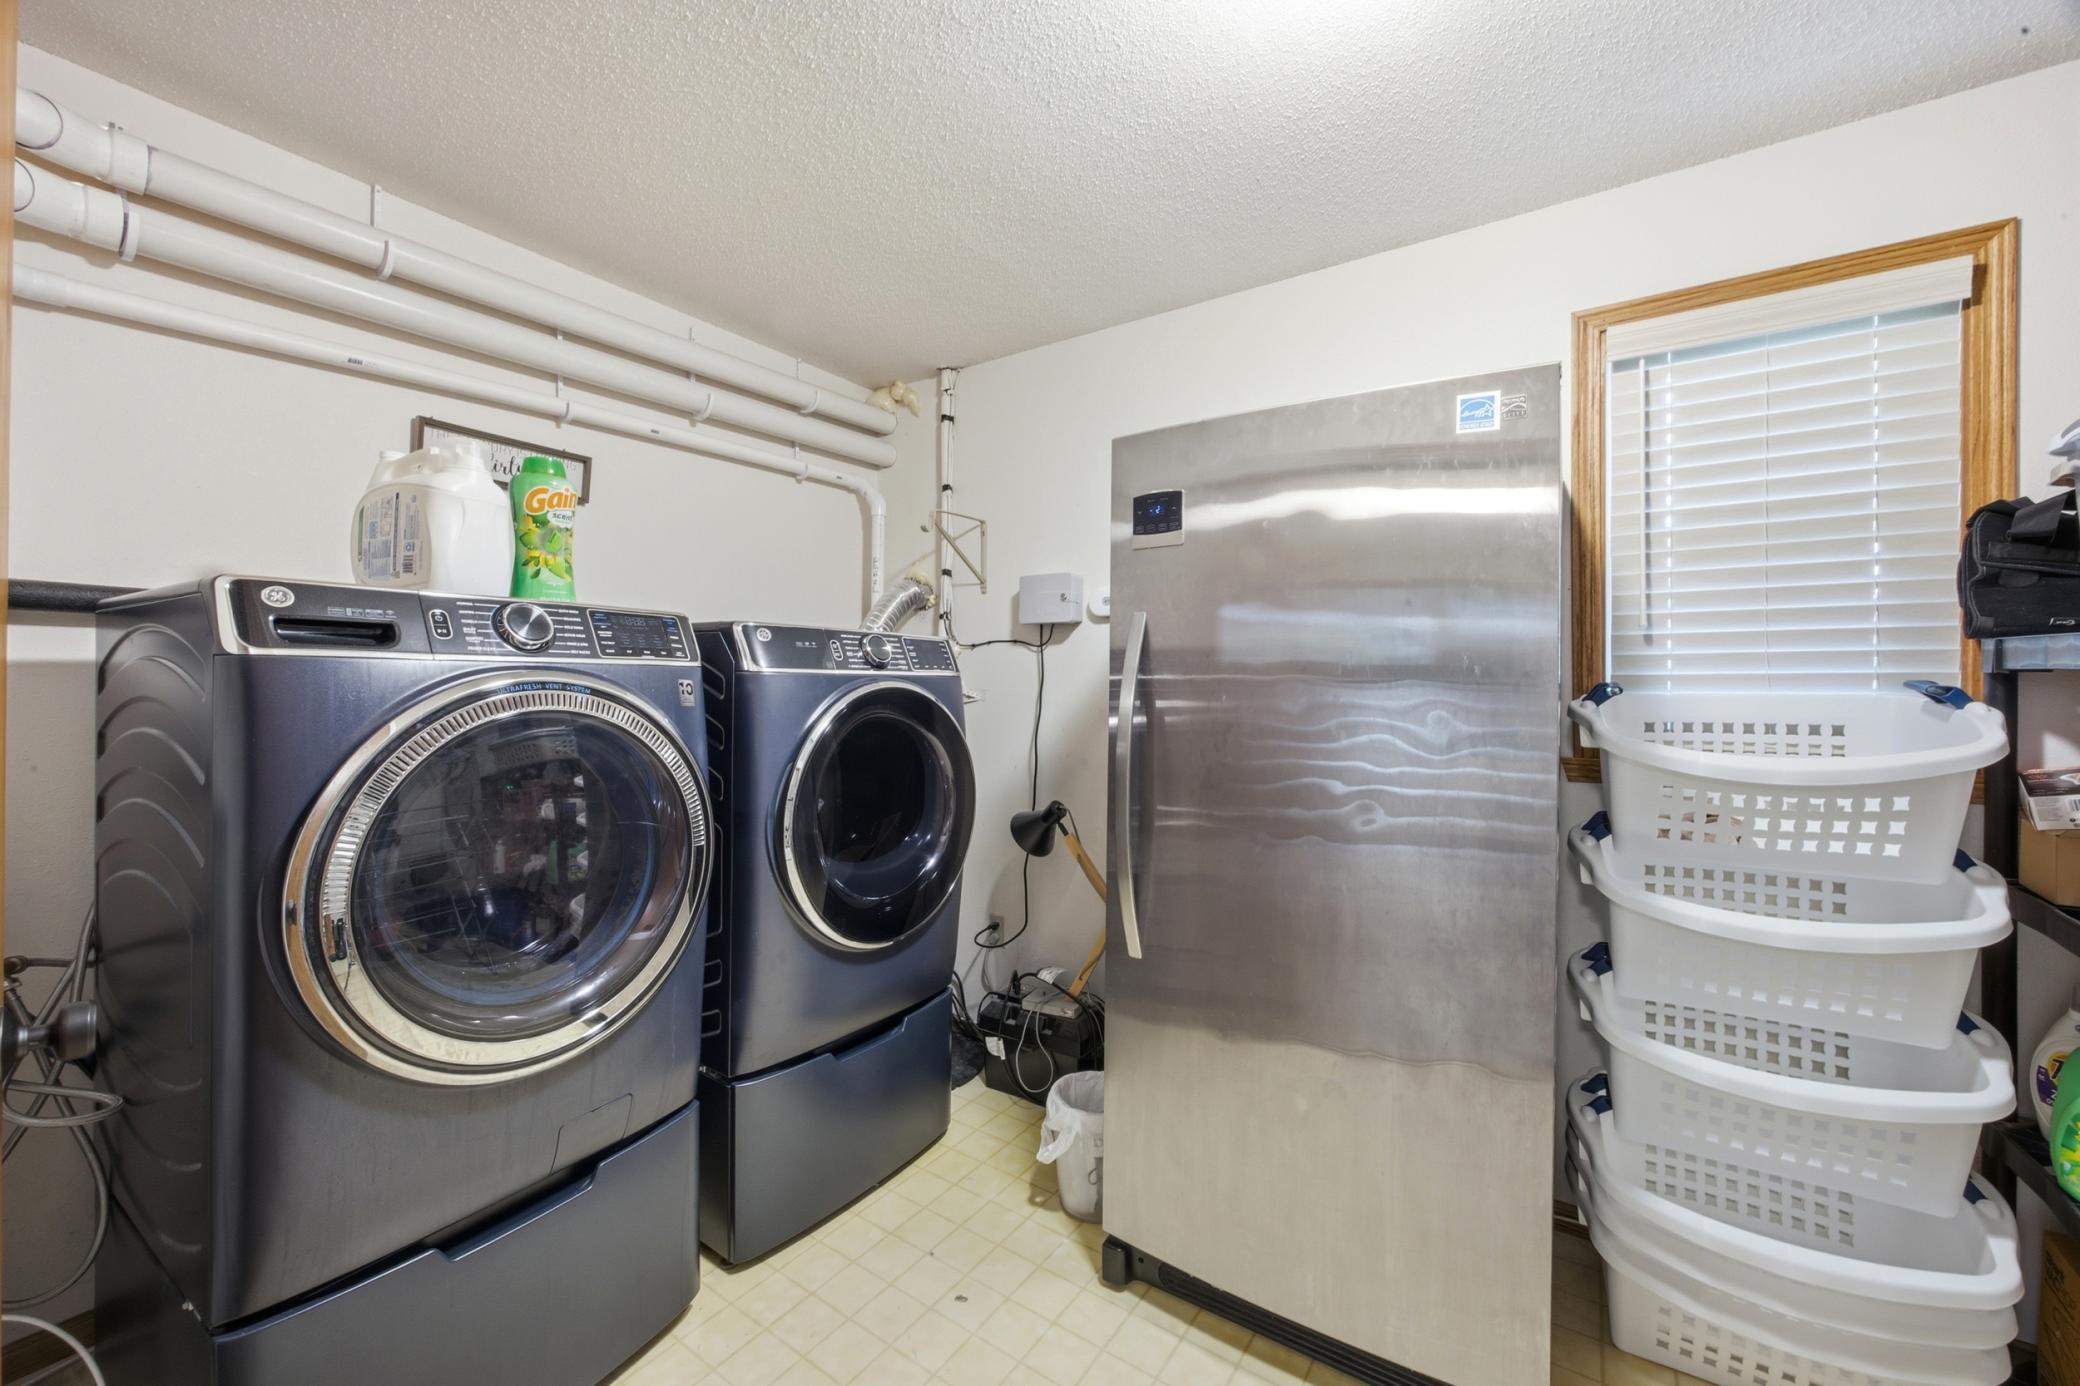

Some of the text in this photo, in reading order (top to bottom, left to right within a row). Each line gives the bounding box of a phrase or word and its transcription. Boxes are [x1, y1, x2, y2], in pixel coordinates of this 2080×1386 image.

[525, 487, 576, 514] Gain
[545, 682, 562, 690] VENT
[566, 685, 591, 694] SYSTEM
